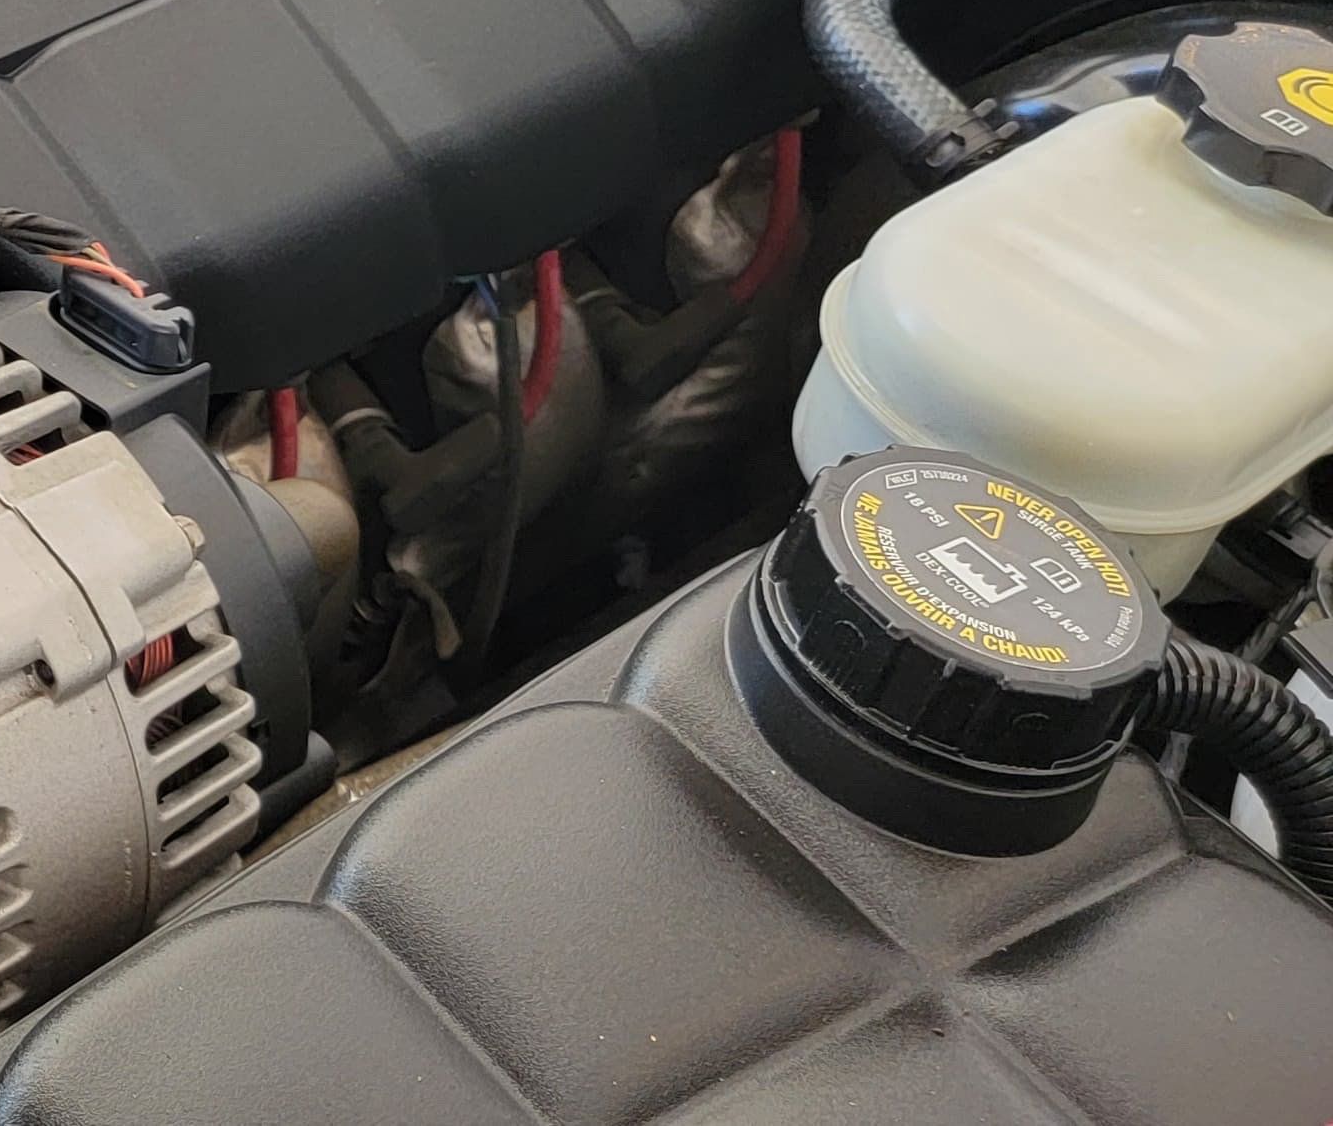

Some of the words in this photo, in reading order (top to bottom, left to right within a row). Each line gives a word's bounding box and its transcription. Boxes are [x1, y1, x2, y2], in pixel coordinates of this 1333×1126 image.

[856, 492, 883, 515] NE
[904, 491, 926, 507] 18
[920, 506, 950, 528] PSI
[854, 511, 892, 570] JAMAIS
[987, 481, 1056, 522] NEVER
[1054, 519, 1107, 559] OPEN
[1094, 561, 1132, 598] HOT!
[1016, 508, 1066, 542] SURGE
[1060, 540, 1095, 570] TANK
[881, 573, 957, 631] OUVRIR
[915, 586, 1017, 642] D'EXPANSION
[1031, 596, 1063, 619] 124
[1058, 619, 1090, 642] kPa
[982, 635, 1070, 664] CHAUD!
